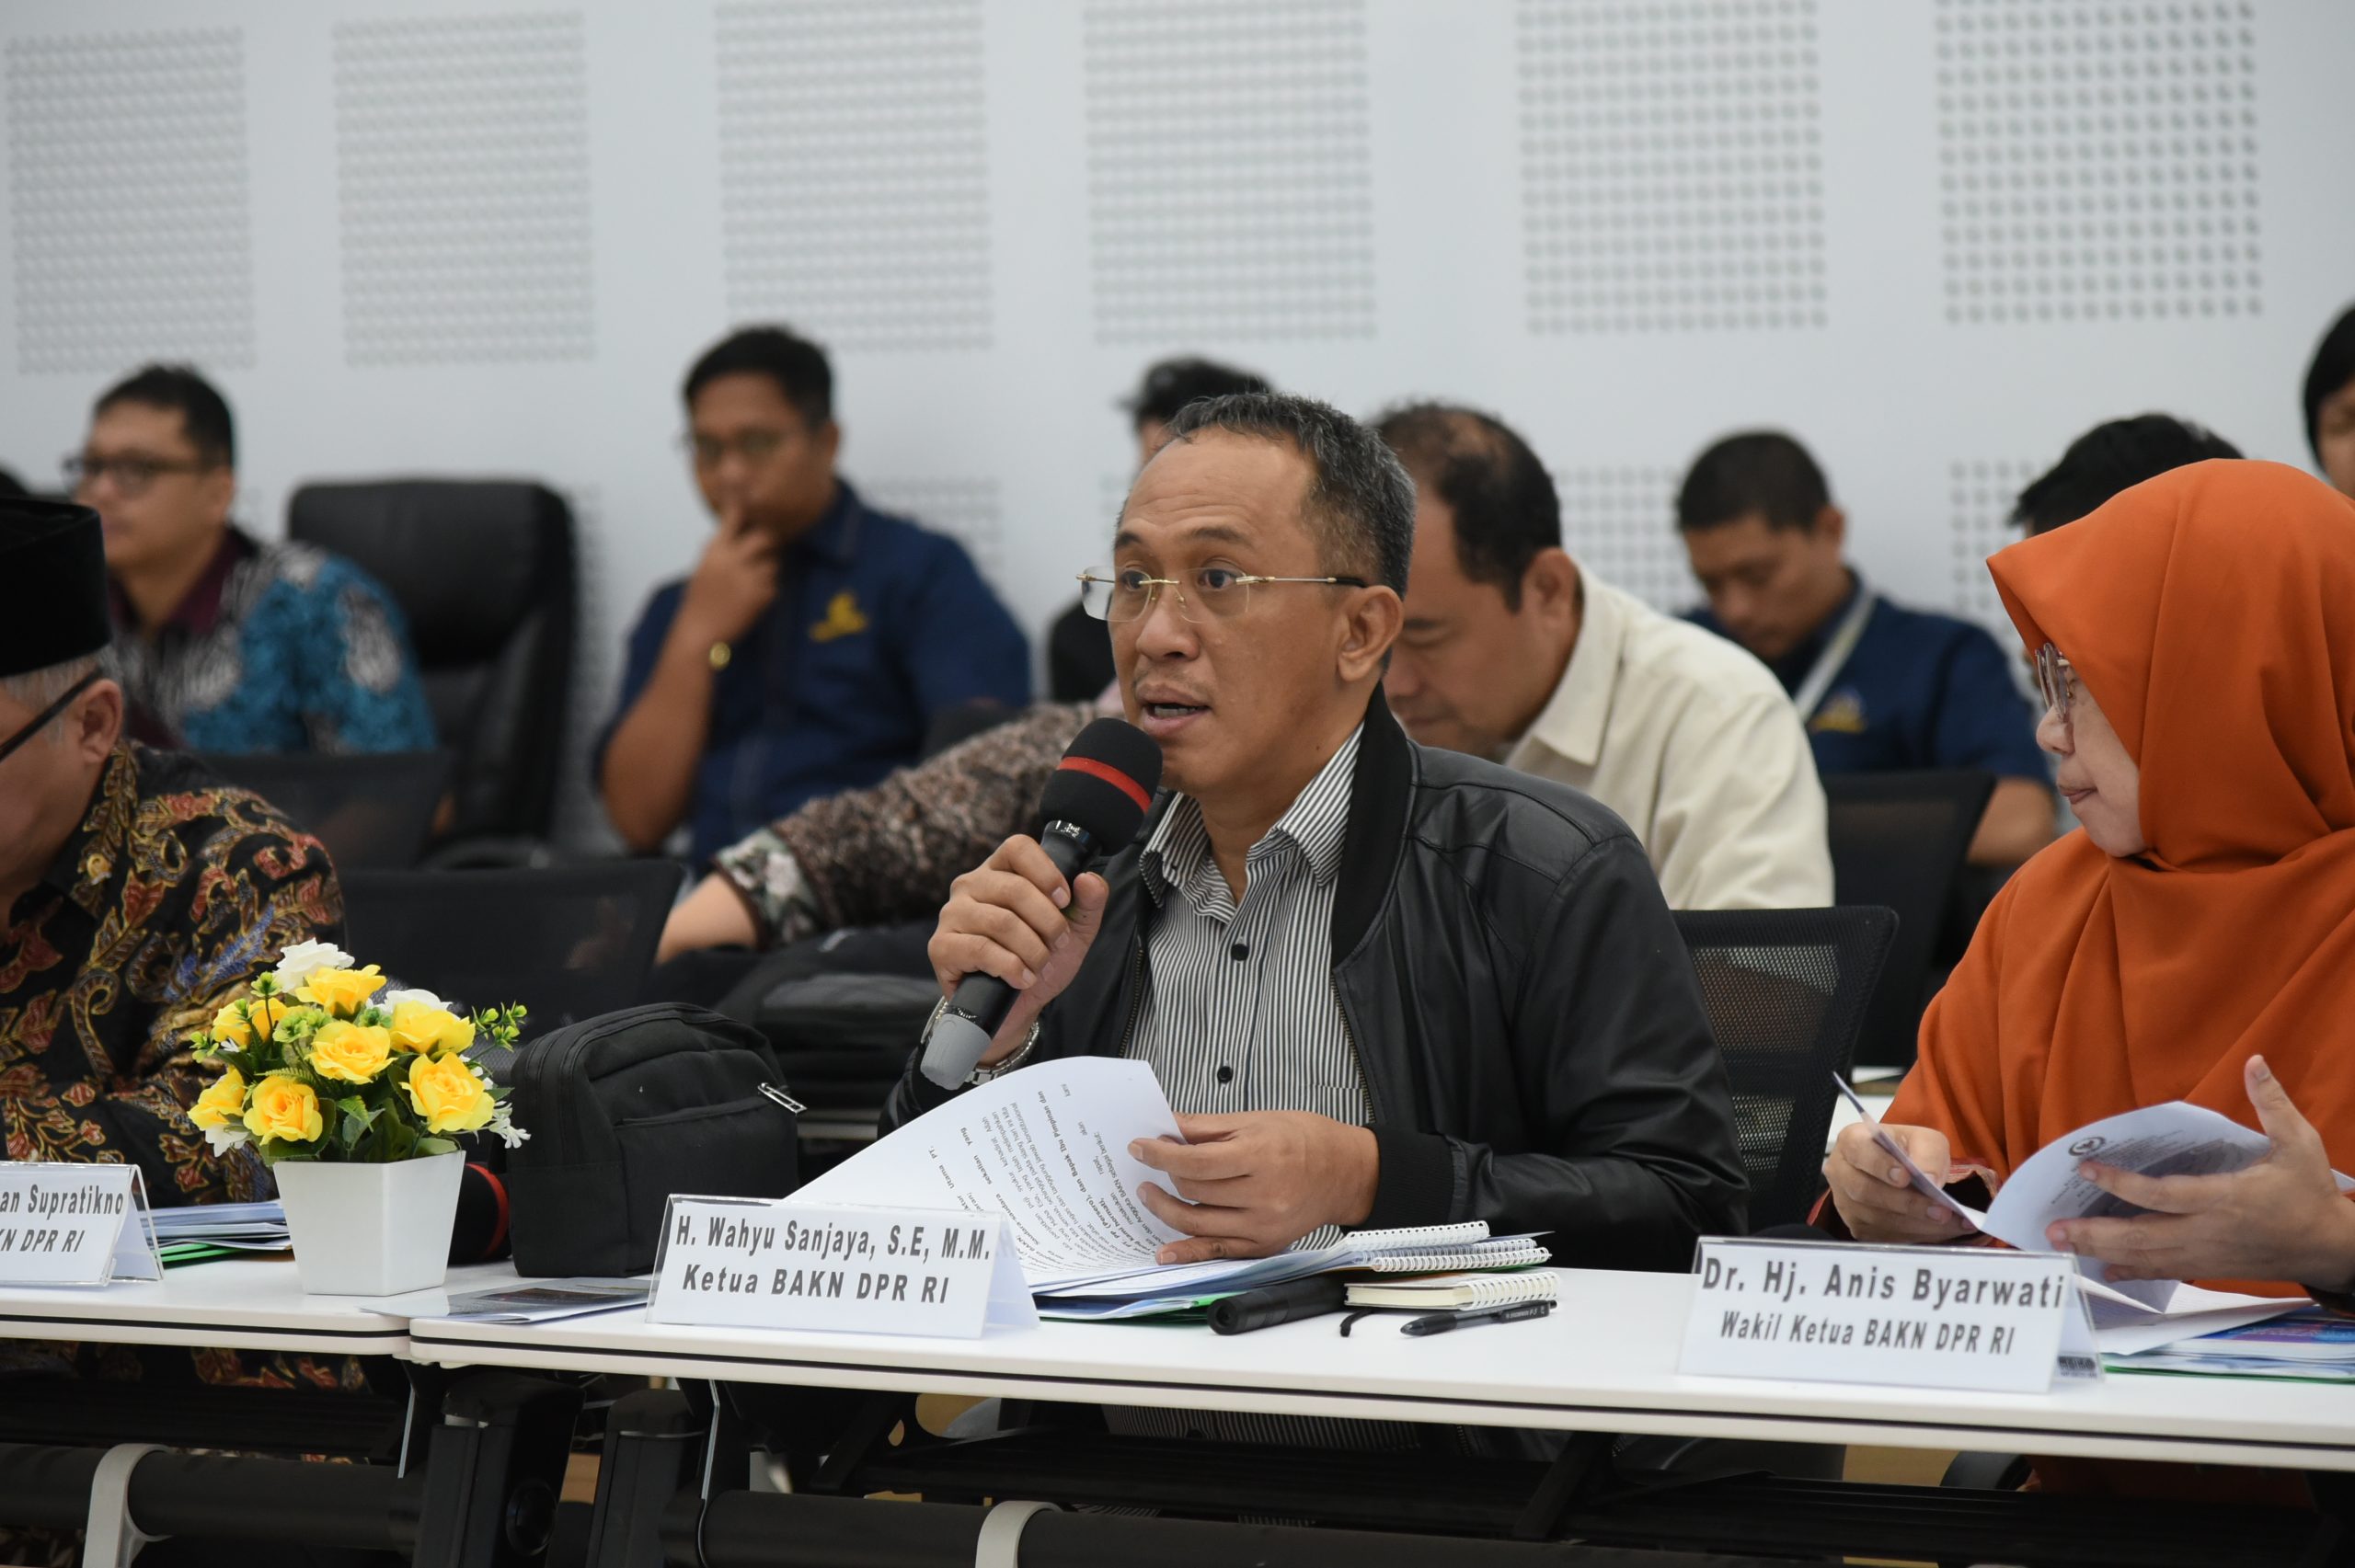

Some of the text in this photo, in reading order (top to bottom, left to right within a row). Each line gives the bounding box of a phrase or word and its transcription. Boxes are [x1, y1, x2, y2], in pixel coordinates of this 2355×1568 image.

[1038, 1091, 1046, 1104] dan
[1061, 1083, 1071, 1097] kami
[992, 1111, 1013, 1152] melimpahkan
[1005, 1118, 1015, 1128] ini
[1009, 1102, 1032, 1144] konstitusional
[1044, 1105, 1060, 1138] Pimpinan
[1077, 1121, 1087, 1135] akan
[960, 1127, 972, 1146] yang
[1010, 1127, 1020, 1141] hari
[1094, 1132, 1107, 1154] berikut:
[928, 1146, 937, 1159] PT.
[991, 1136, 1008, 1167] kehadirat
[1017, 1140, 1028, 1159] siang
[1029, 1144, 1043, 1163] jawab
[1058, 1139, 1067, 1152] Ibu
[973, 1155, 992, 1185] sekalian
[1011, 1155, 1023, 1173] telah
[1026, 1159, 1038, 1175] pada
[1064, 1154, 1077, 1177] Bapak
[1092, 1155, 1104, 1174] rapat,
[1103, 1154, 1117, 1178] sebagai
[938, 1164, 954, 1188] Utama
[1008, 1172, 1023, 1192] syukur
[1021, 1174, 1034, 1191] yang
[1039, 1163, 1058, 1195] tanggung
[1076, 1178, 1086, 1192] dan
[1034, 1176, 1053, 1205] sehingga
[1113, 1178, 1126, 1197] BAKN
[29, 1185, 123, 1219] Supratikno
[1023, 1196, 1035, 1208] puji
[1056, 1195, 1066, 1207] dan
[1086, 1194, 1111, 1229] (Persero),
[1099, 1197, 1120, 1227] hormati,
[1110, 1192, 1133, 1224] melakukan
[1124, 1197, 1143, 1222] Anggota
[1035, 1212, 1060, 1239] panjatkan
[1118, 1227, 1134, 1242] kami
[1142, 1223, 1153, 1234] dan
[20, 1230, 58, 1252] DPR
[62, 1230, 85, 1252] RI
[676, 1216, 695, 1245] H.
[708, 1217, 775, 1256] Wahyu
[785, 1220, 875, 1261] Sanjaya,
[888, 1225, 928, 1264] S.E,
[942, 1229, 989, 1259] M.M.
[683, 1265, 948, 1303] Ketua BAKN DPR RI
[1702, 1256, 2063, 1310] Dr. Hj. Anis Byarwati
[1721, 1311, 2014, 1354] Wakil Ketua BAKN DPR RI
